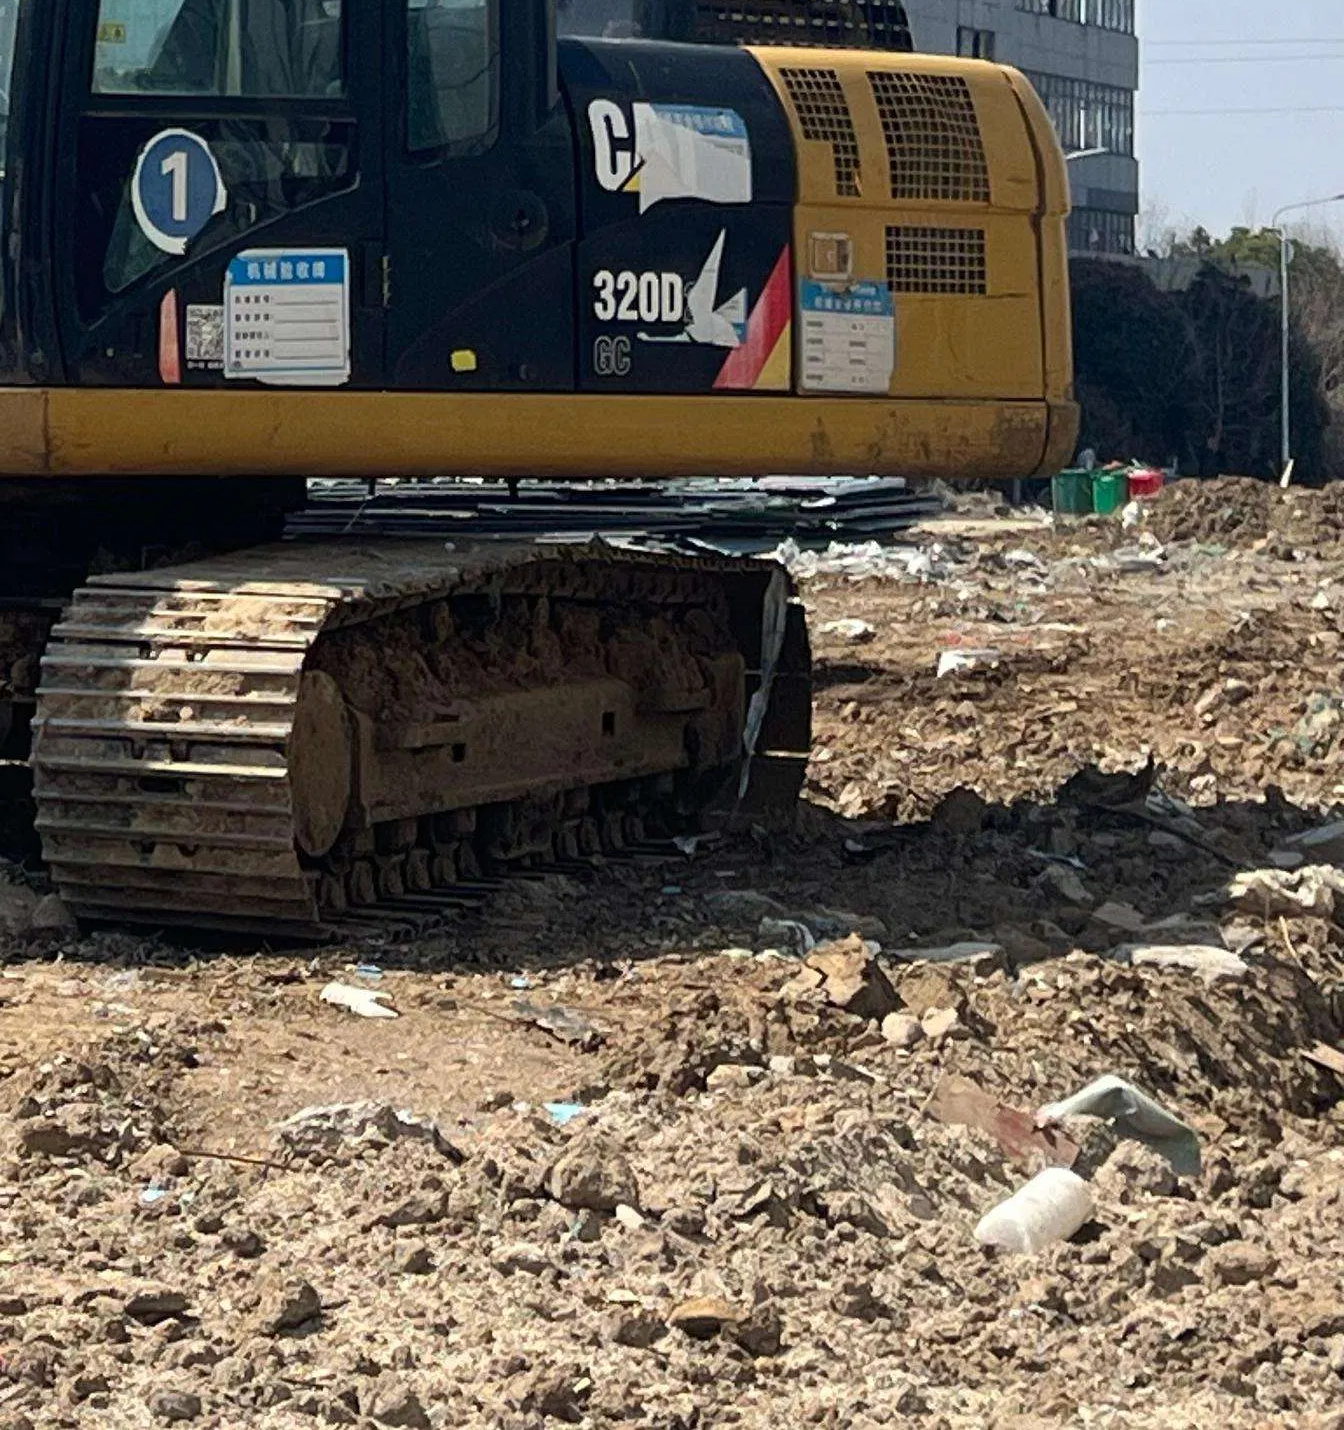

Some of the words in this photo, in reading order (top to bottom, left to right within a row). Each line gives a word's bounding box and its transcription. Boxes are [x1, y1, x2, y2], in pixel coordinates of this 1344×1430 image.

[161, 151, 188, 221] 1
[593, 269, 693, 322] 320D
[594, 335, 631, 375] GC
